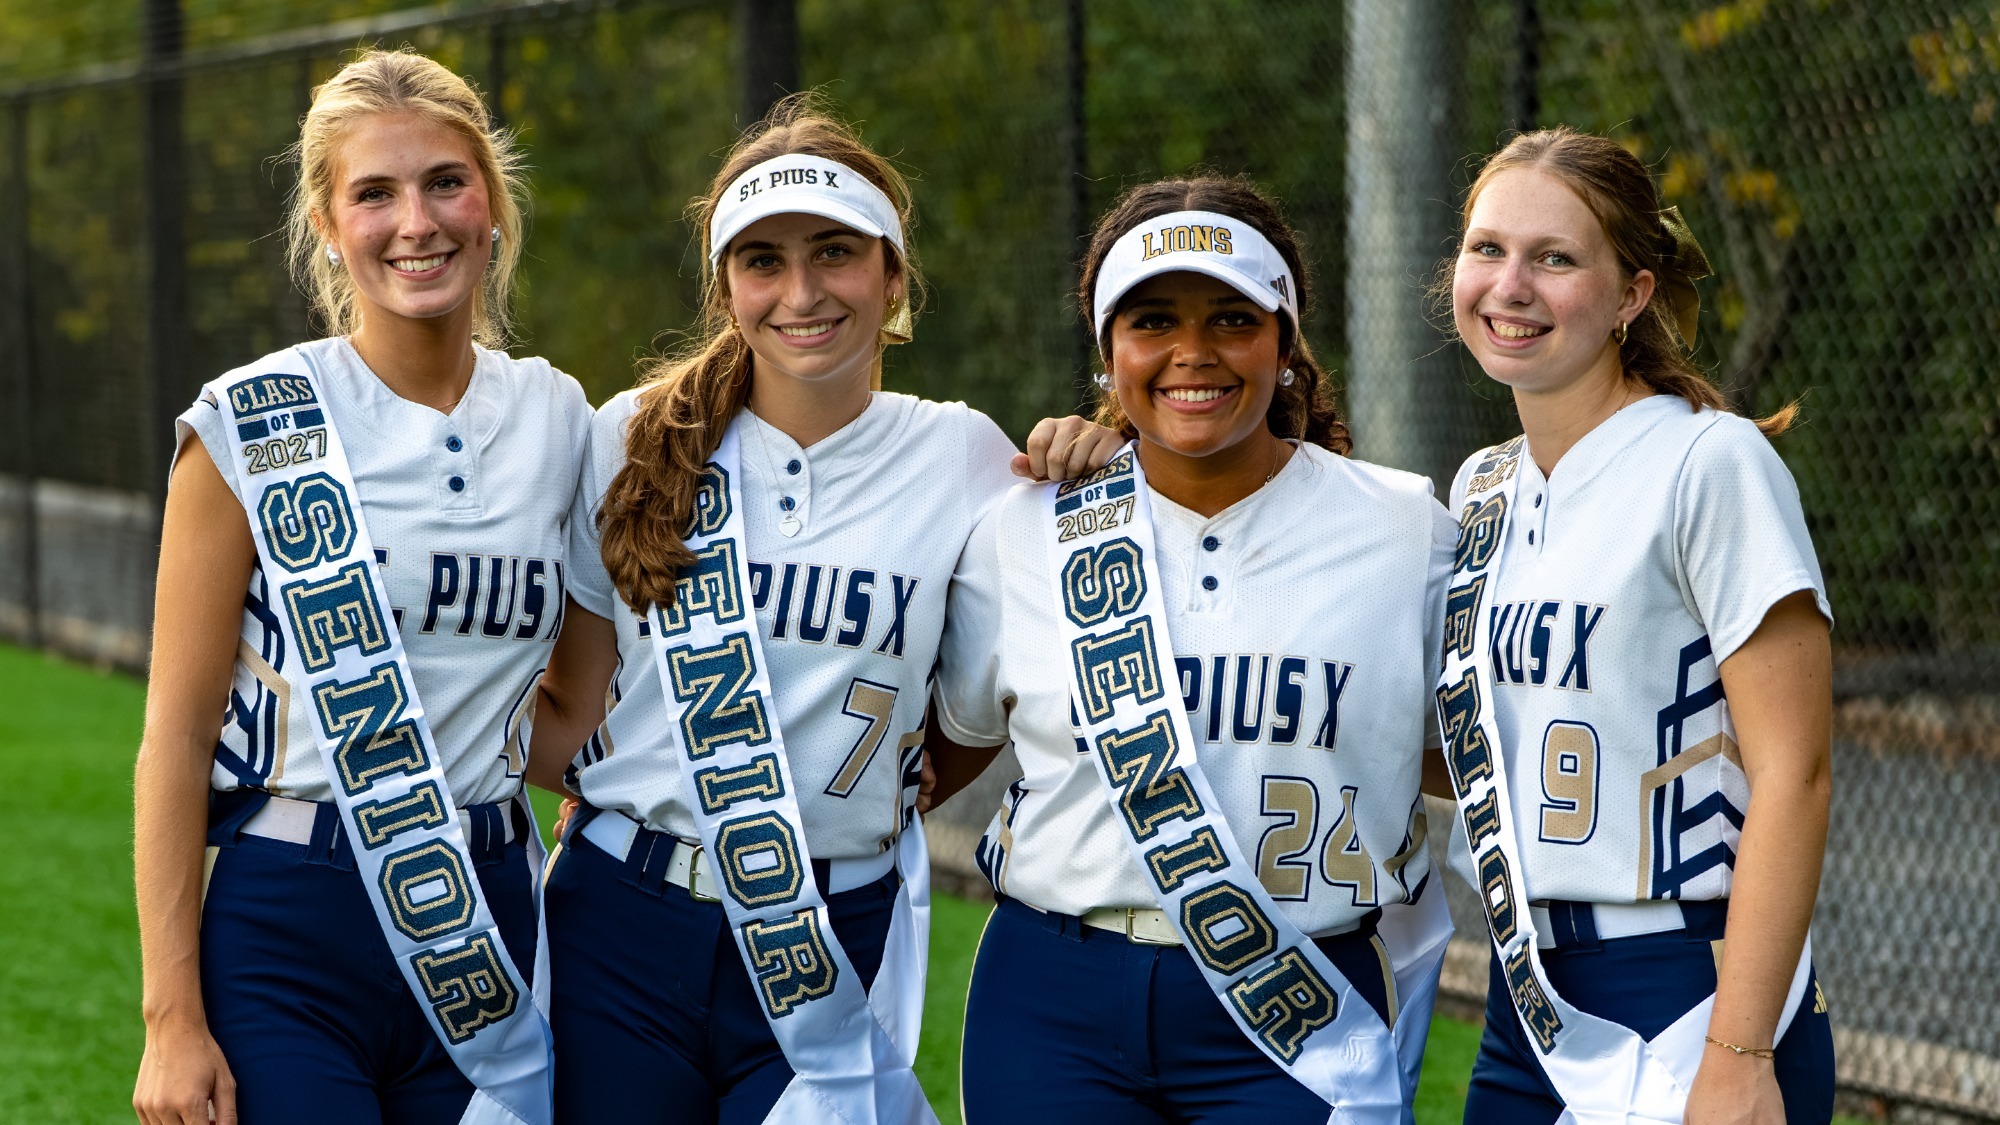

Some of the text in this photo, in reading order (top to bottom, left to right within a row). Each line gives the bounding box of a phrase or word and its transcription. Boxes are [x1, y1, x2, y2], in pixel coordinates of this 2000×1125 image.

[740, 168, 839, 202] ST. PIUS X
[1142, 225, 1233, 262] LIONS
[231, 378, 313, 413] CLASS
[270, 413, 291, 432] OF
[242, 427, 327, 476] 2027
[1084, 485, 1103, 503] OF
[1056, 494, 1136, 543] 2027
[419, 551, 548, 641] PIUS
[873, 570, 920, 660] X
[1489, 600, 1610, 694] IUS X
[824, 677, 899, 799] 7
[1307, 658, 1355, 753] X
[257, 471, 519, 1046] SENIOR
[1061, 536, 1338, 1066] SENIOR
[1539, 719, 1600, 846] 9
[1256, 775, 1378, 907] 24
